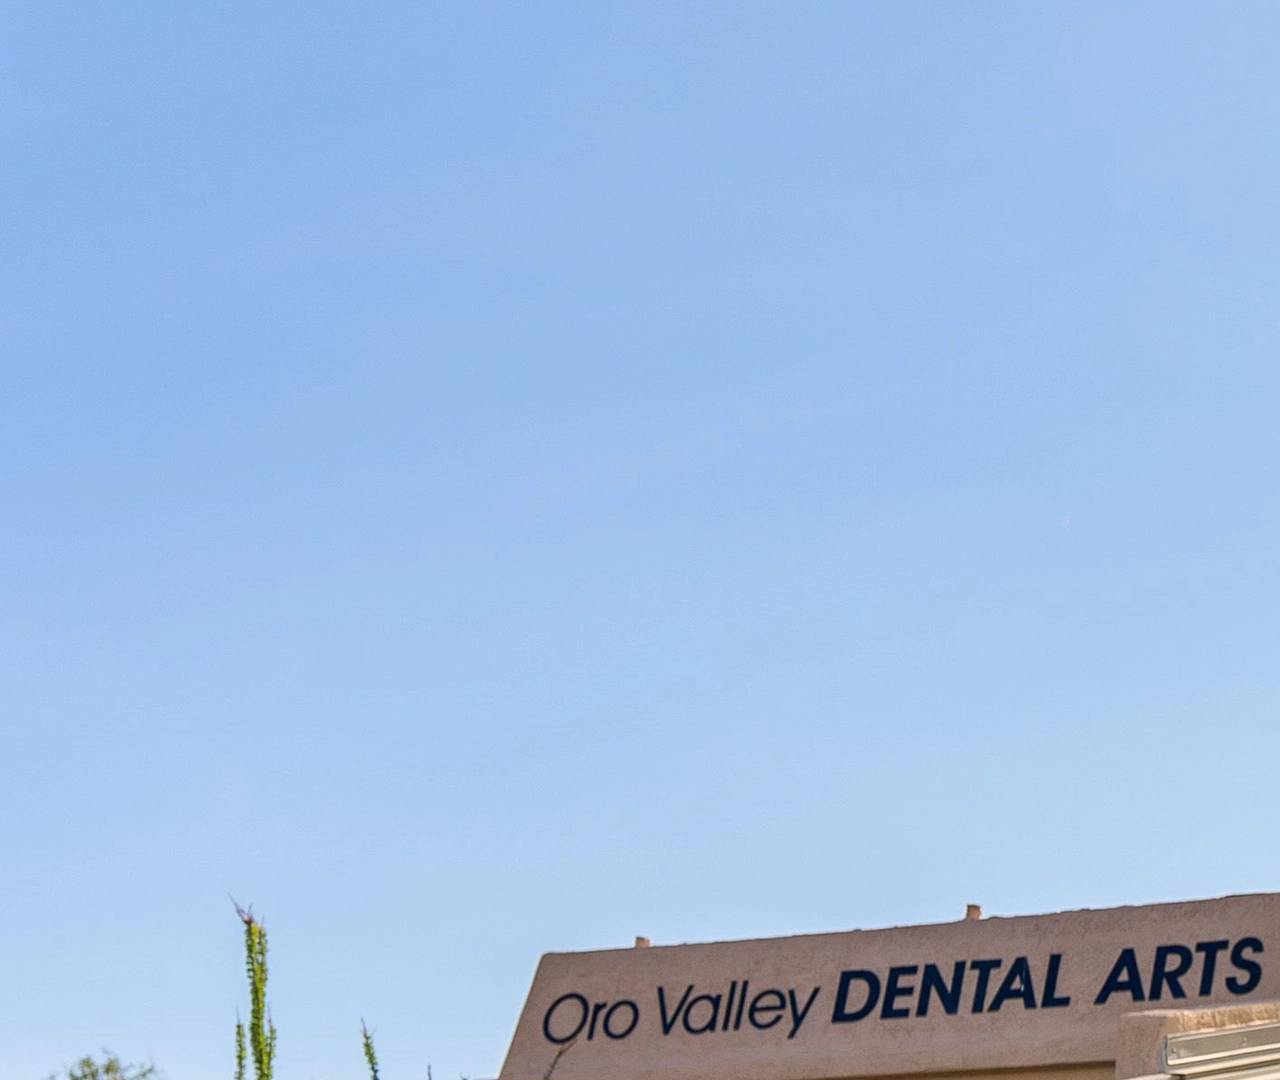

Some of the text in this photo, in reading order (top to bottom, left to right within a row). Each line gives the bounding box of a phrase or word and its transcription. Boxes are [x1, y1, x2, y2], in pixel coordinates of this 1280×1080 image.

[542, 936, 1264, 1044] Oro Valley DENTAL ARTS
